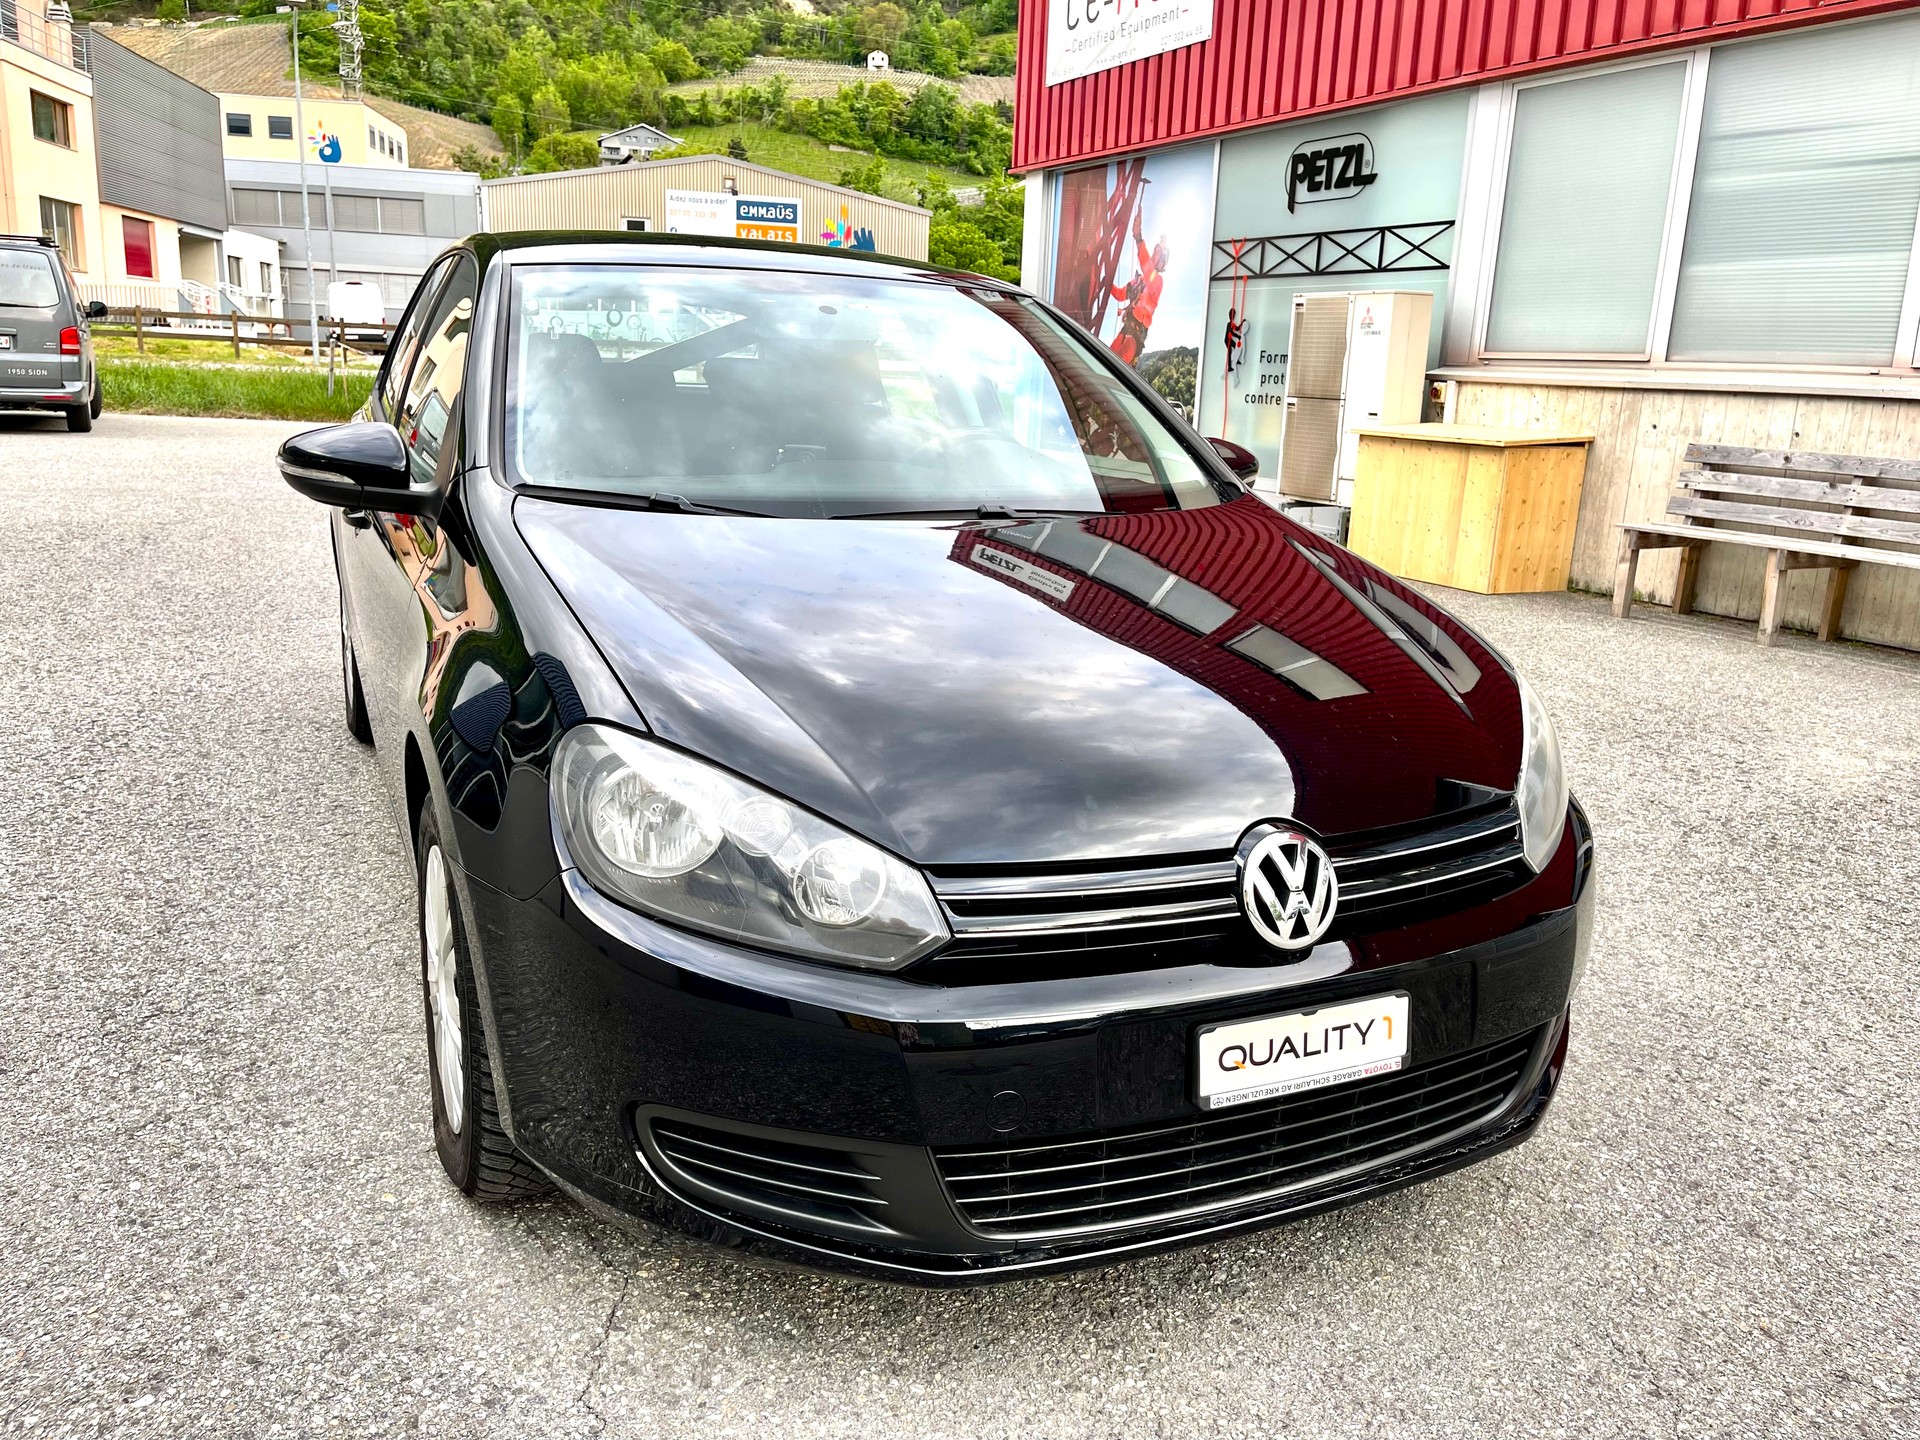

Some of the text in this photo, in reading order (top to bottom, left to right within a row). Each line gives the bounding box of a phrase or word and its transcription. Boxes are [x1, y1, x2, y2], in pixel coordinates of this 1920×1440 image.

[1287, 143, 1379, 214] PETZL
[7, 368, 48, 377] 1950 SION
[1244, 392, 1282, 406] contre
[1218, 1016, 1393, 1072] QUALITY 1
[1225, 1061, 1393, 1103] TOYOTA GARAGE SCHLAURI AG KREUZLINGEN
